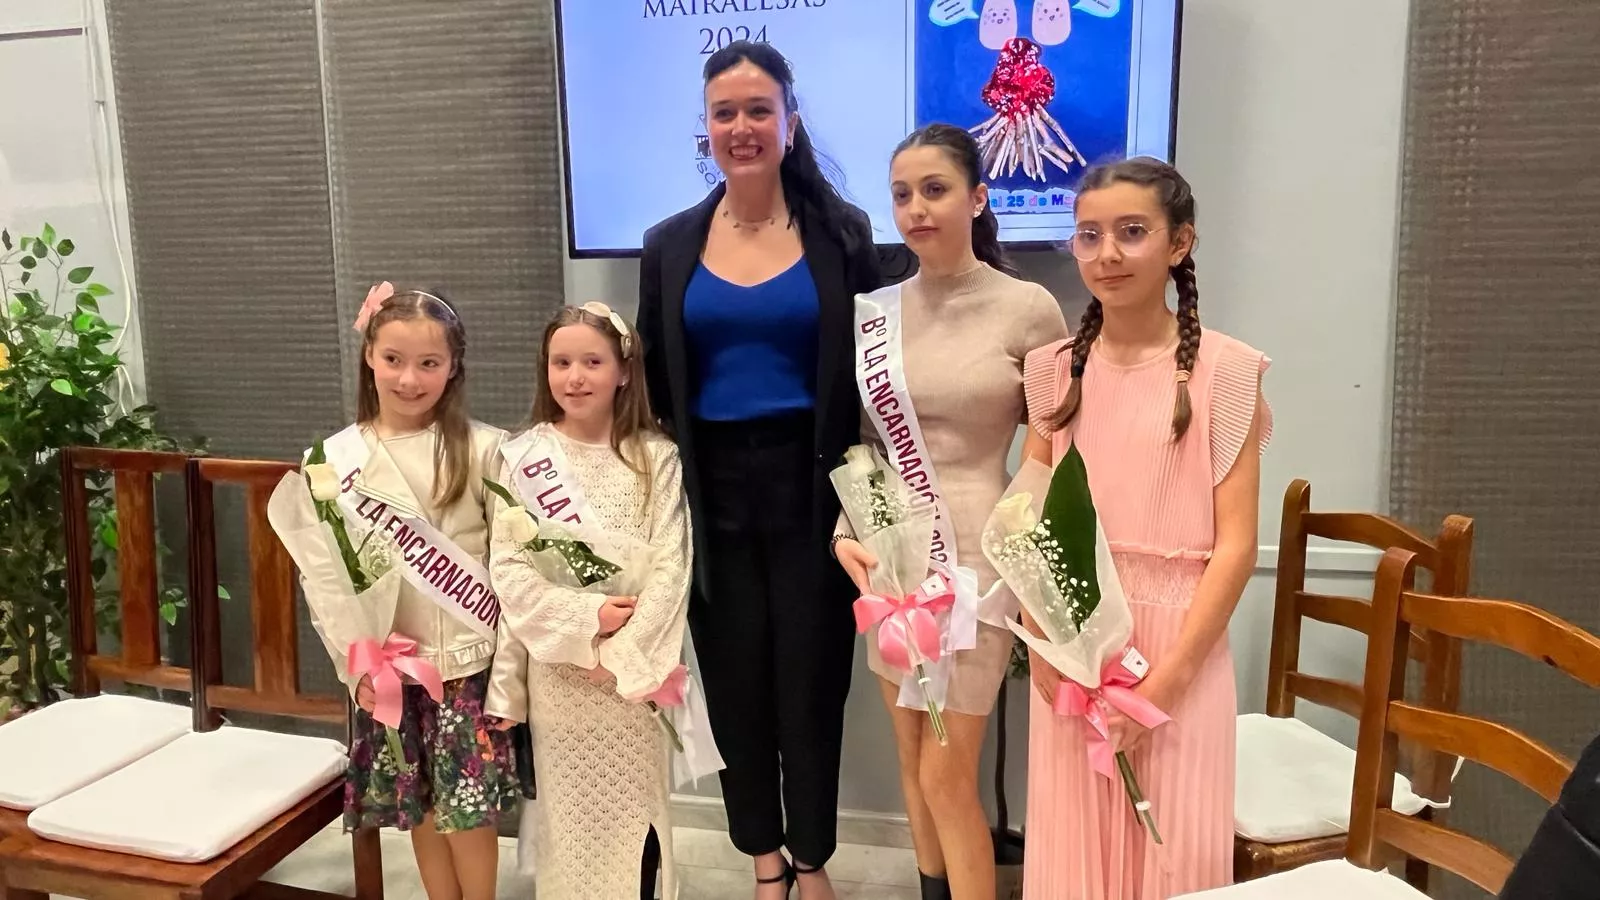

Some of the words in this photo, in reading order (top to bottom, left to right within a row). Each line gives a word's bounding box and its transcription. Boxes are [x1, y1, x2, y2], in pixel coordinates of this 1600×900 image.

[1006, 195, 1025, 207] 25
[1029, 195, 1048, 207] de
[864, 340, 888, 372] LA
[355, 497, 388, 527] LA
[536, 483, 571, 519] LA
